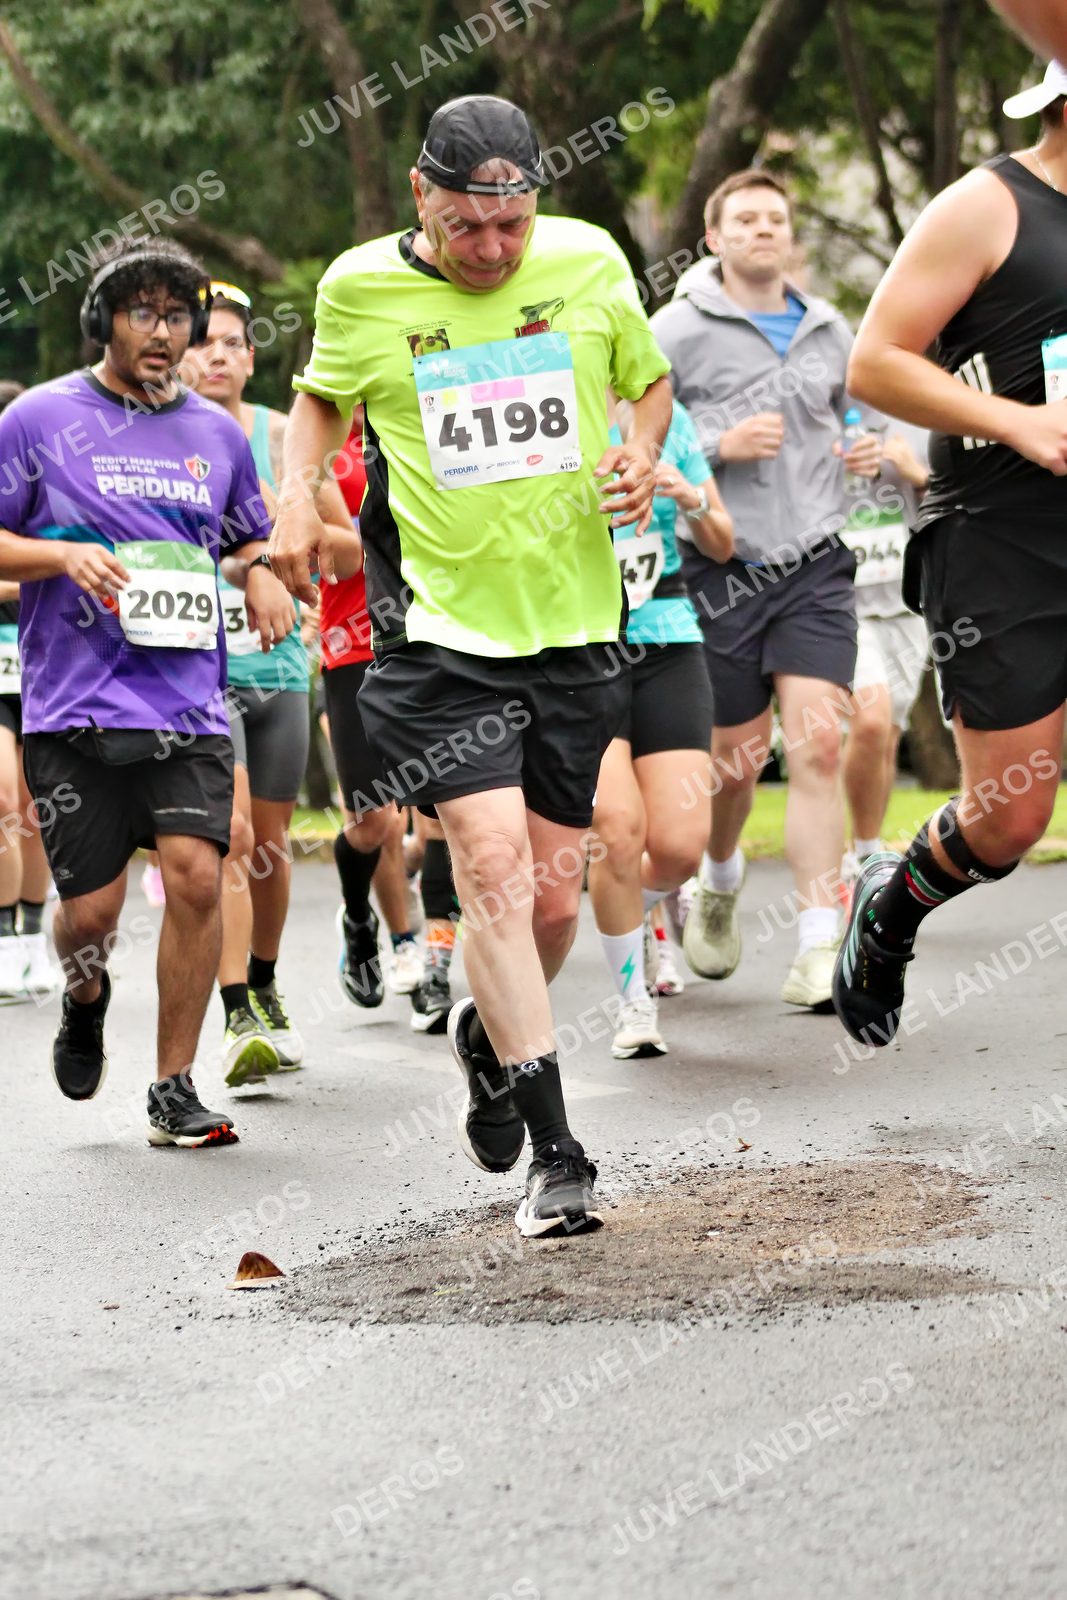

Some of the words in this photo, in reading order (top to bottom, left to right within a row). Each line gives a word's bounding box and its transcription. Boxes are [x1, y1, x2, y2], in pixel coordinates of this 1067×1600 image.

[438, 397, 569, 452] 4198
[91, 455, 128, 465] MEDIO
[129, 457, 180, 470] MARATÓN
[94, 464, 122, 473] CLUB
[124, 465, 157, 475] ATLAS
[444, 465, 480, 478] PERDURA
[96, 473, 212, 507] PERDURA
[619, 552, 657, 584] 47
[127, 589, 213, 623] 2029
